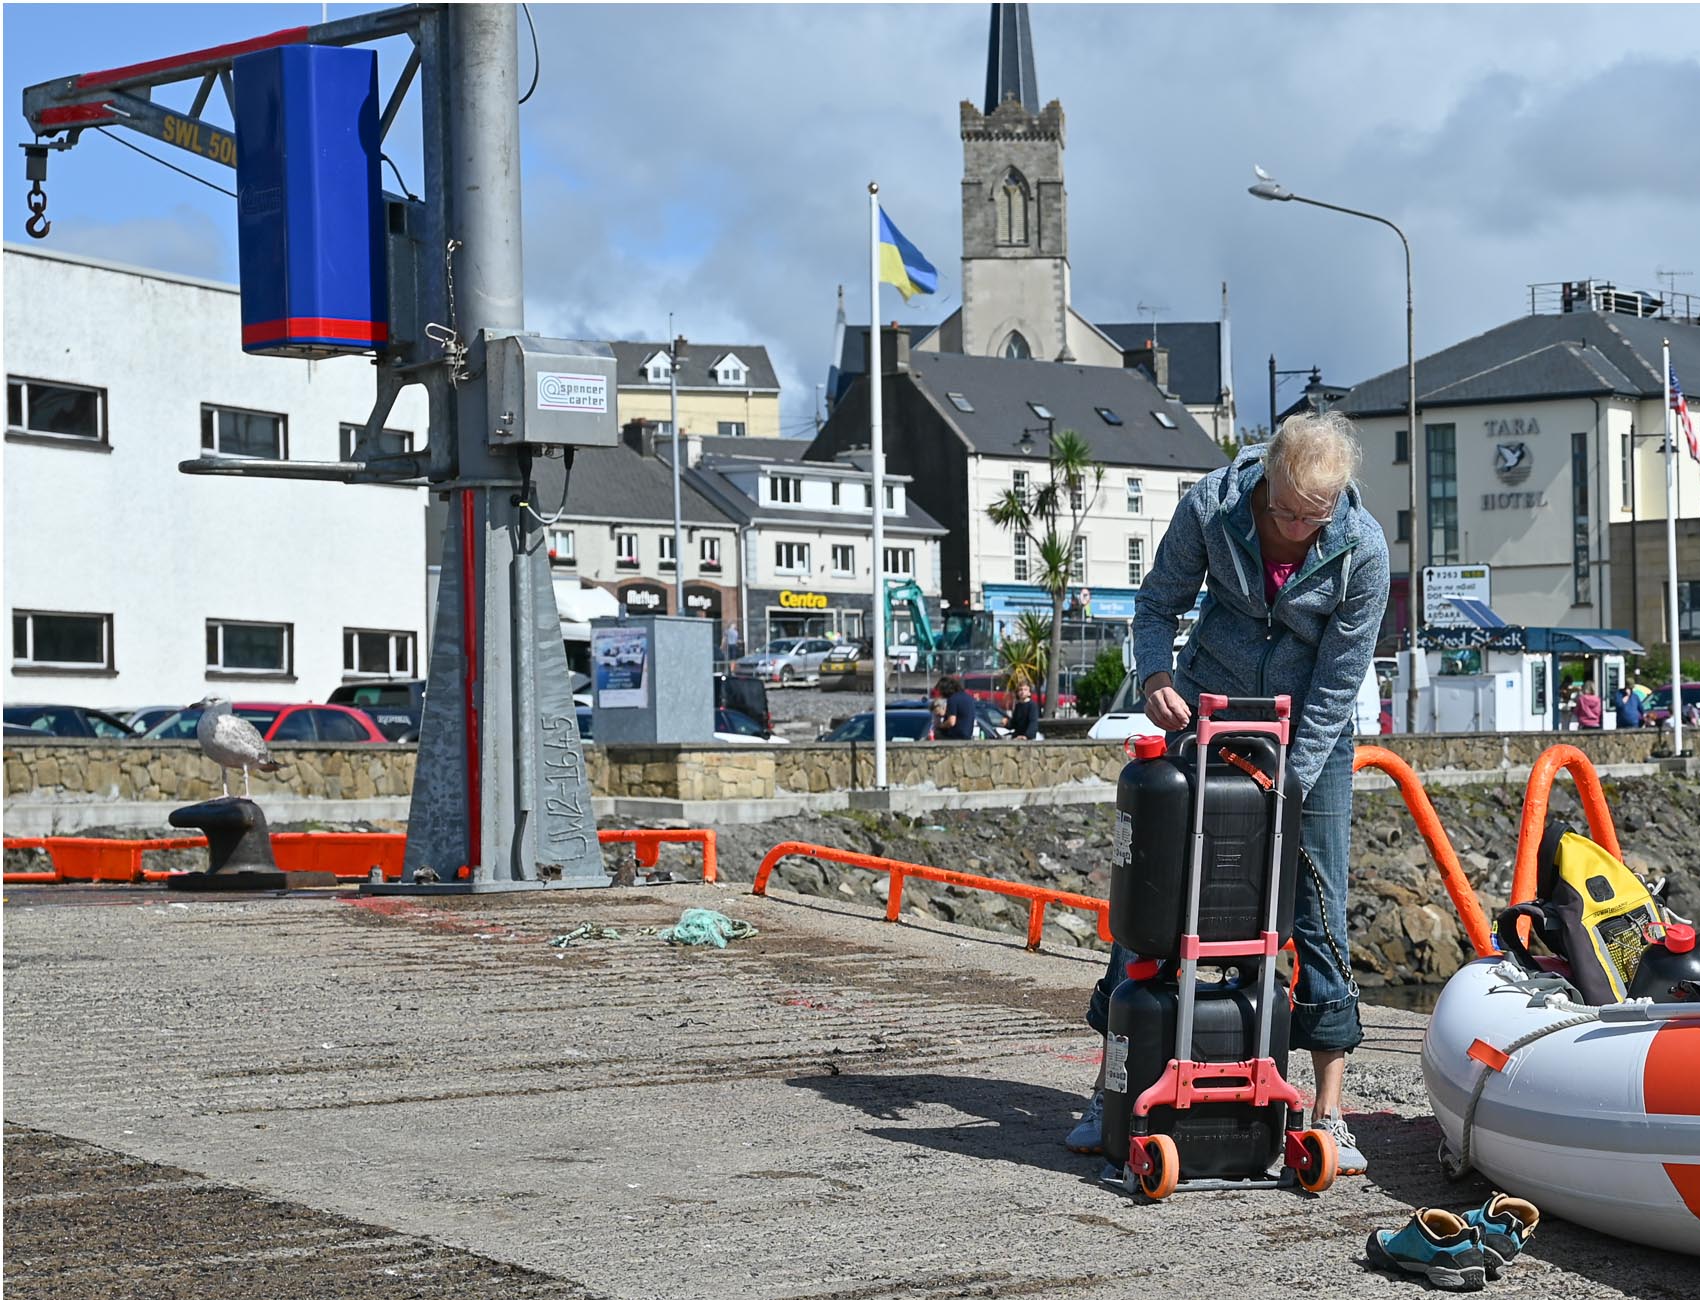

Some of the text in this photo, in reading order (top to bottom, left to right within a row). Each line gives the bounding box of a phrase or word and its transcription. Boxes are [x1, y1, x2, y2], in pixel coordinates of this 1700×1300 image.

[163, 115, 202, 153] SWL
[560, 384, 604, 396] spencer
[569, 396, 605, 406] carter
[1484, 418, 1541, 437] TARA
[1481, 491, 1549, 511] HOTEL
[779, 590, 828, 609] Centra
